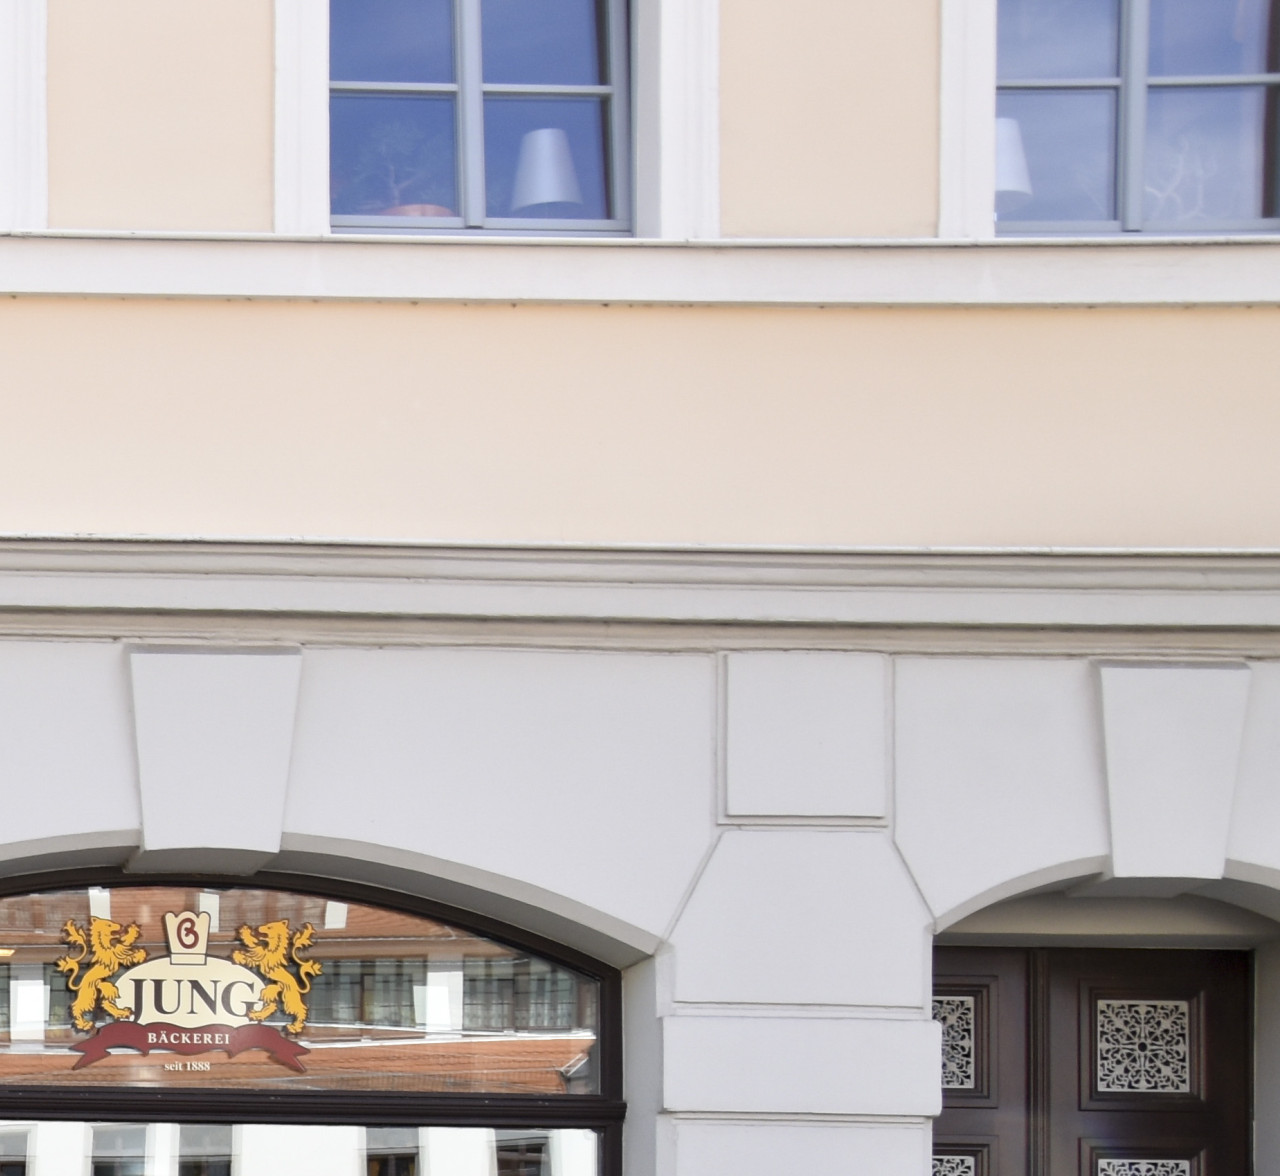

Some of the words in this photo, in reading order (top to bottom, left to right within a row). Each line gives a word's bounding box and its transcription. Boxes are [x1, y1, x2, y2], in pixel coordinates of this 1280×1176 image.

[129, 978, 258, 1021] JUNG
[147, 1030, 230, 1045] BÄCKEREI
[164, 1061, 183, 1071] seit
[186, 1061, 210, 1071] 1888
